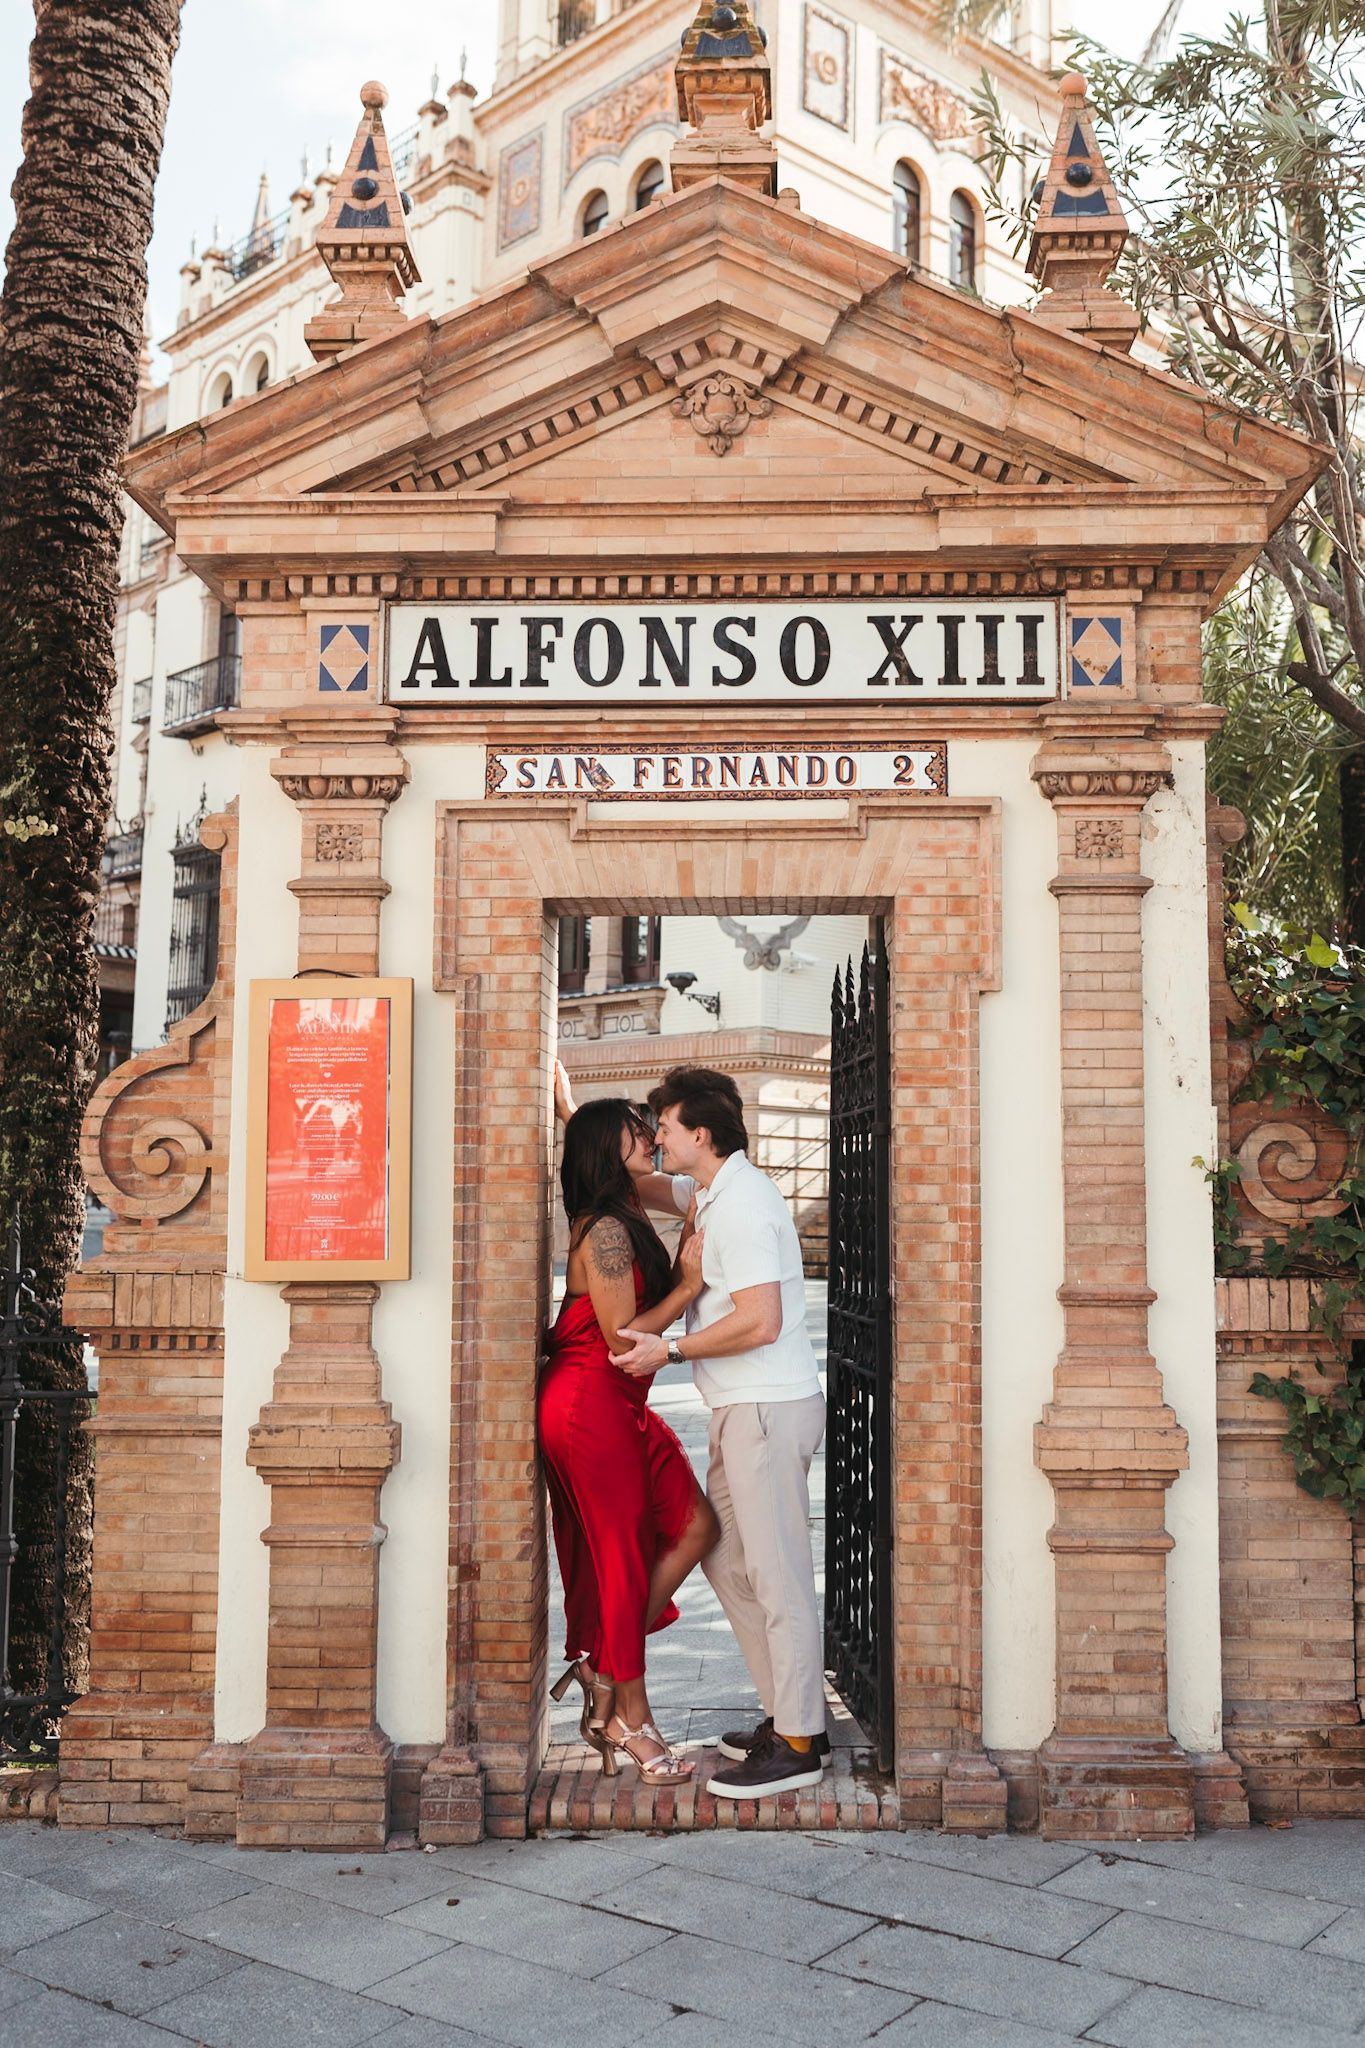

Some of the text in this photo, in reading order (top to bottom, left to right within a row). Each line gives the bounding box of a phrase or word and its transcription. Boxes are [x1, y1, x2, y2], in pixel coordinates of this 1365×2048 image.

[401, 615, 1045, 688] ALFONSO XIII
[516, 755, 915, 789] SAN FERNANDO 2
